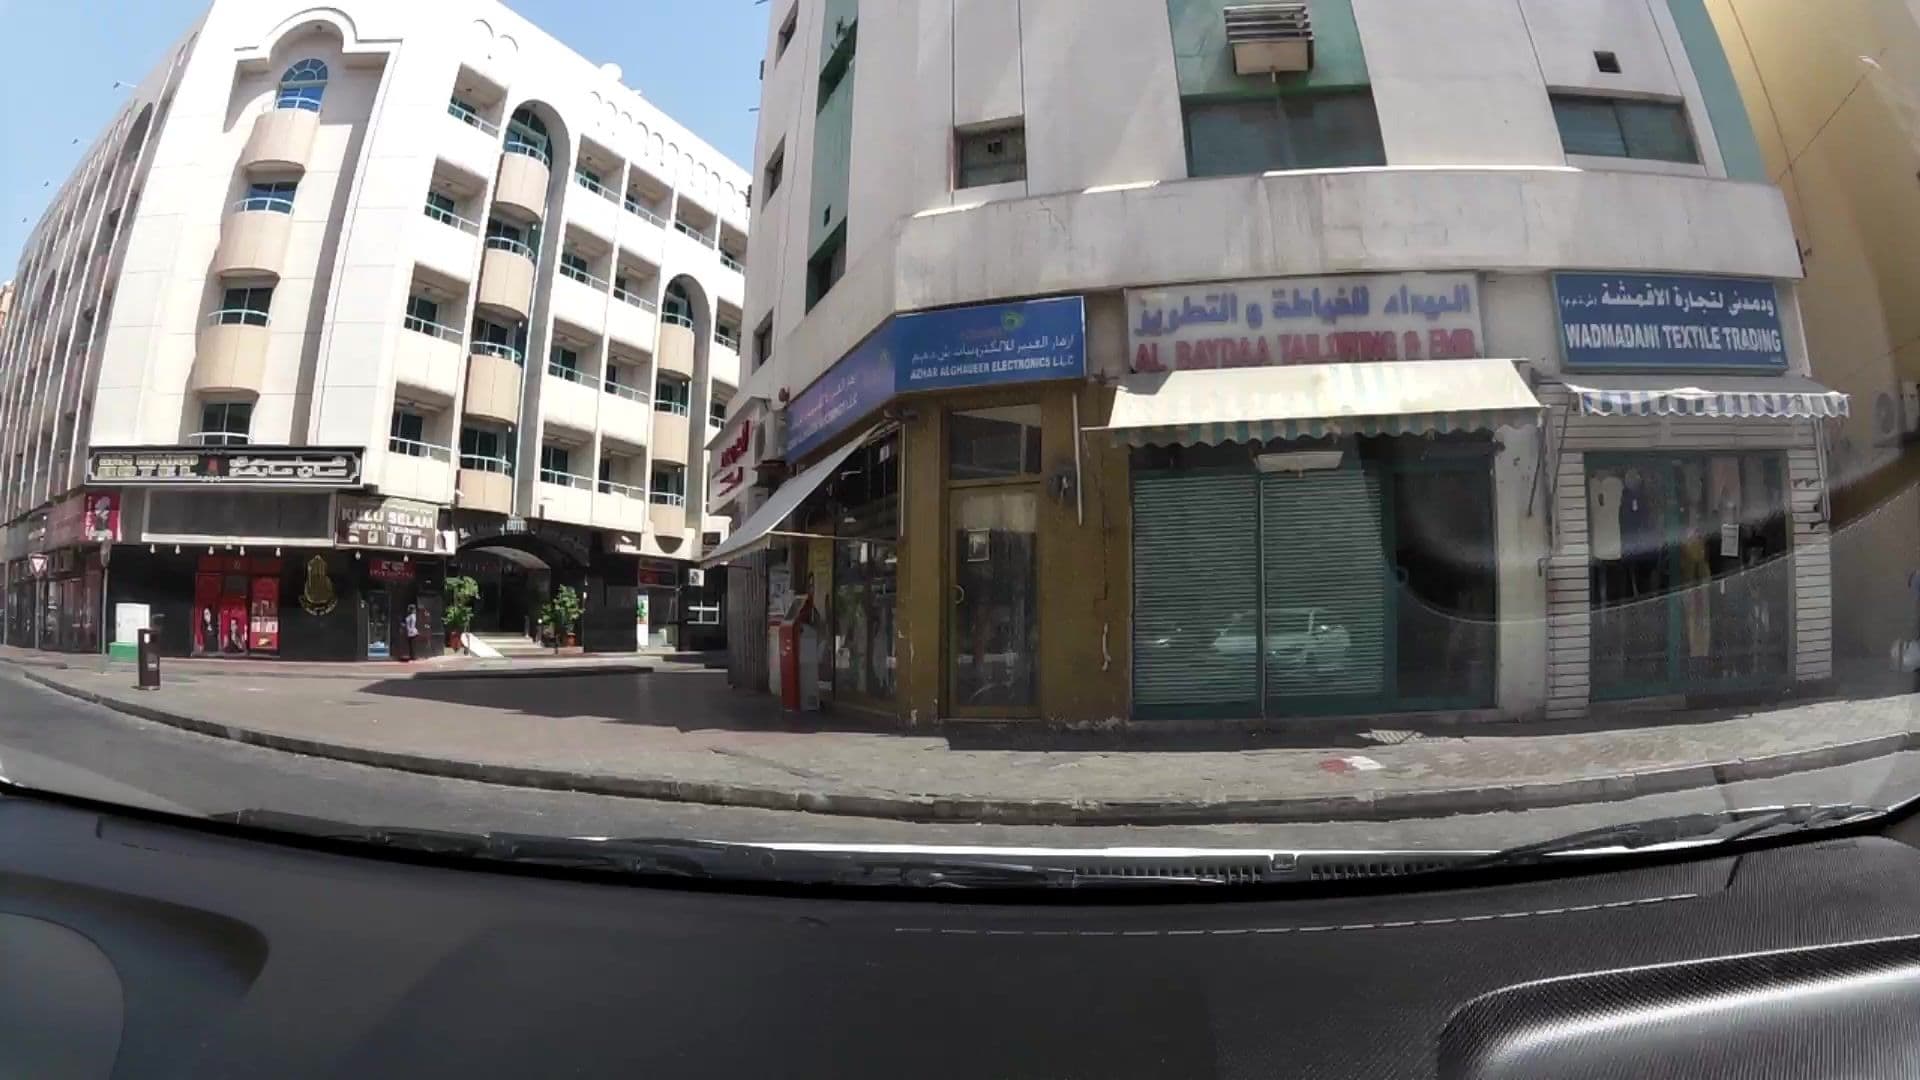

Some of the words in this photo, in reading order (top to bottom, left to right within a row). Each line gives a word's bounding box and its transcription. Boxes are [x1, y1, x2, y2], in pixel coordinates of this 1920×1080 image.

[1673, 286, 1724, 314] لتجارة
[1246, 303, 1263, 329] و
[1564, 323, 1660, 349] WADMADANI
[1662, 325, 1721, 350] TEXTILE
[1722, 327, 1782, 353] TRADING
[991, 356, 1050, 372] ELECTRONICS
[1134, 342, 1168, 373] AL
